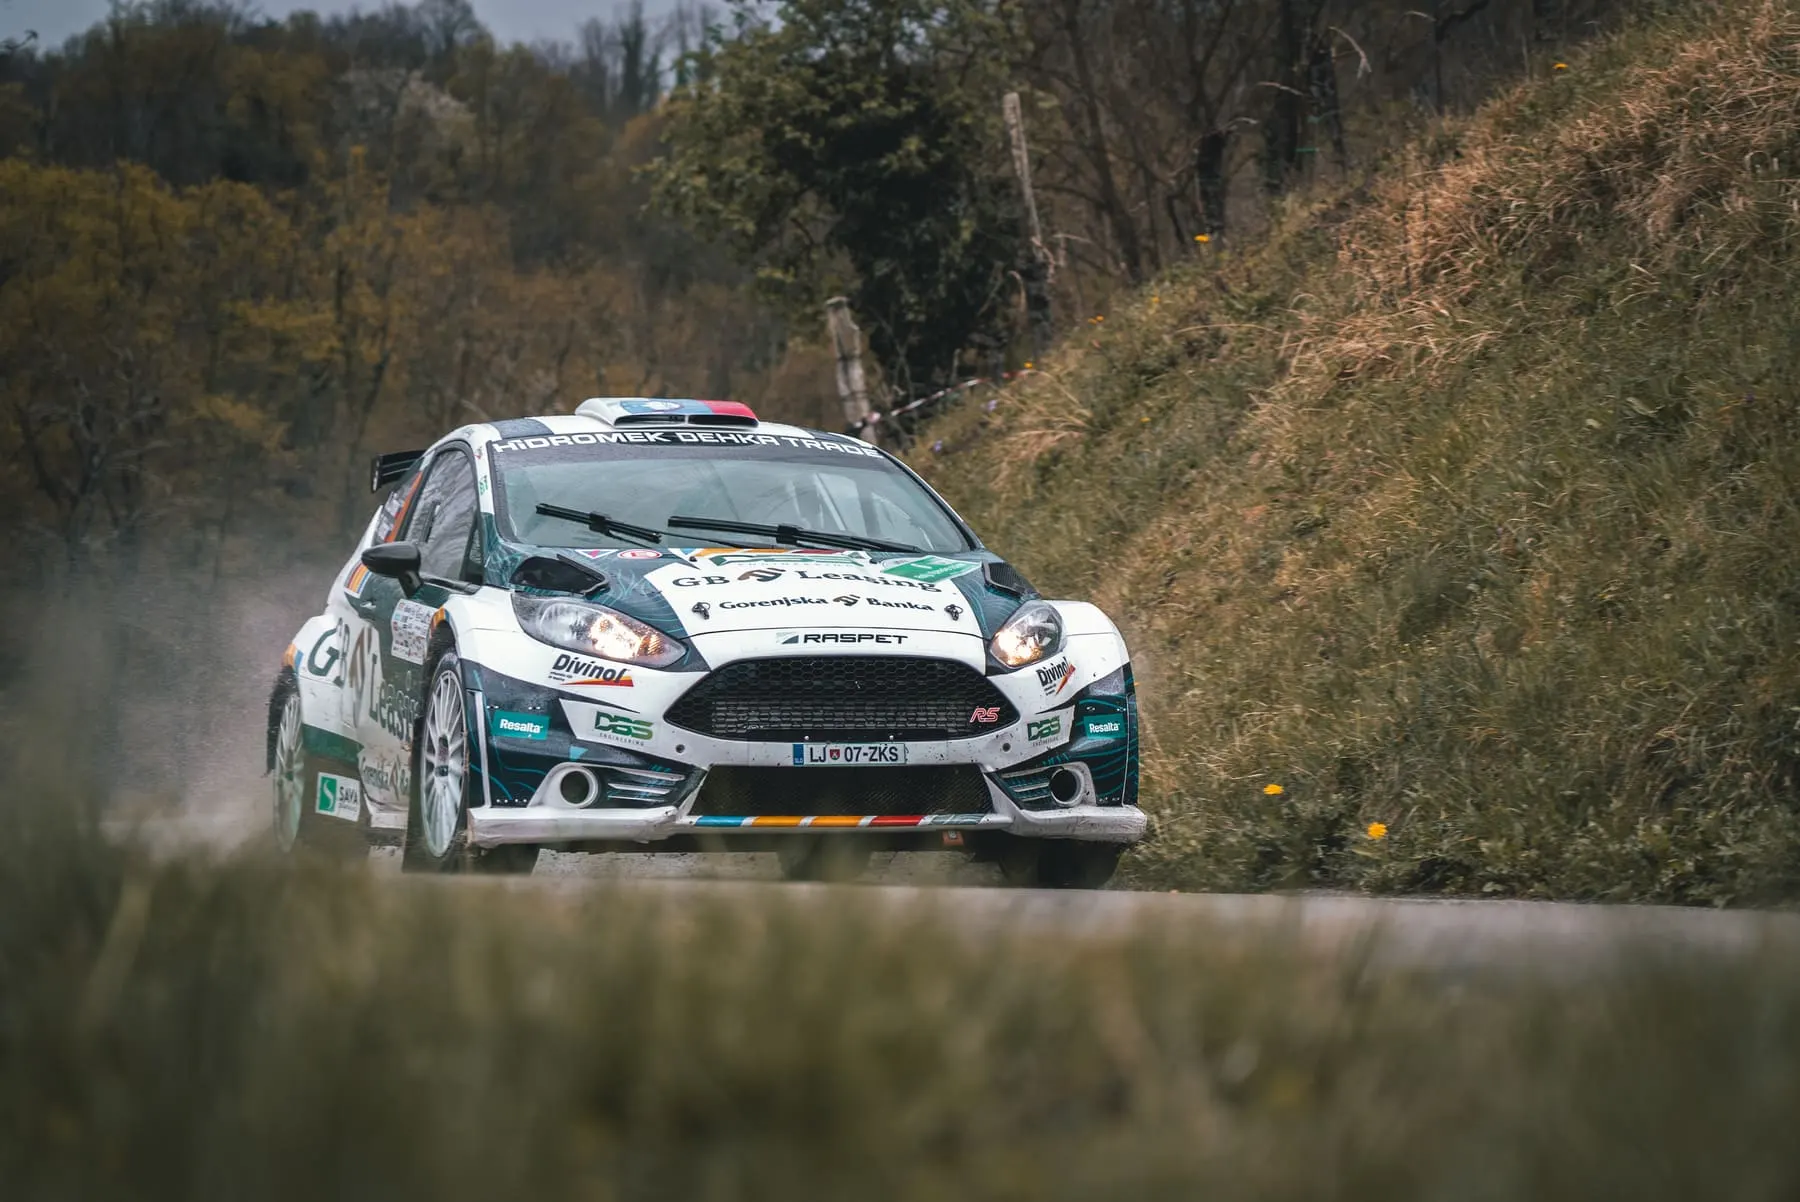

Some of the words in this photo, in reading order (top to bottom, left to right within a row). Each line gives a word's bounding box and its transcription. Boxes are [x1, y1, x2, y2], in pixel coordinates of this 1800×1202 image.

[676, 432, 780, 446] DEHKA
[782, 437, 884, 458] TRADE
[672, 575, 730, 587] GB
[794, 570, 942, 592] Leasing
[718, 596, 828, 610] Gorenjska
[867, 597, 934, 611] Banka
[803, 633, 908, 645] RASPET
[552, 654, 627, 683] Divinol
[970, 707, 1000, 723] RS
[500, 719, 541, 734] Resalta
[594, 711, 653, 740] DBS
[1089, 723, 1119, 734] Resalta
[599, 732, 645, 747] ENGINEERING
[809, 746, 826, 763] LJ
[844, 746, 899, 763] 07-ZKS
[339, 786, 358, 804] SAVA
